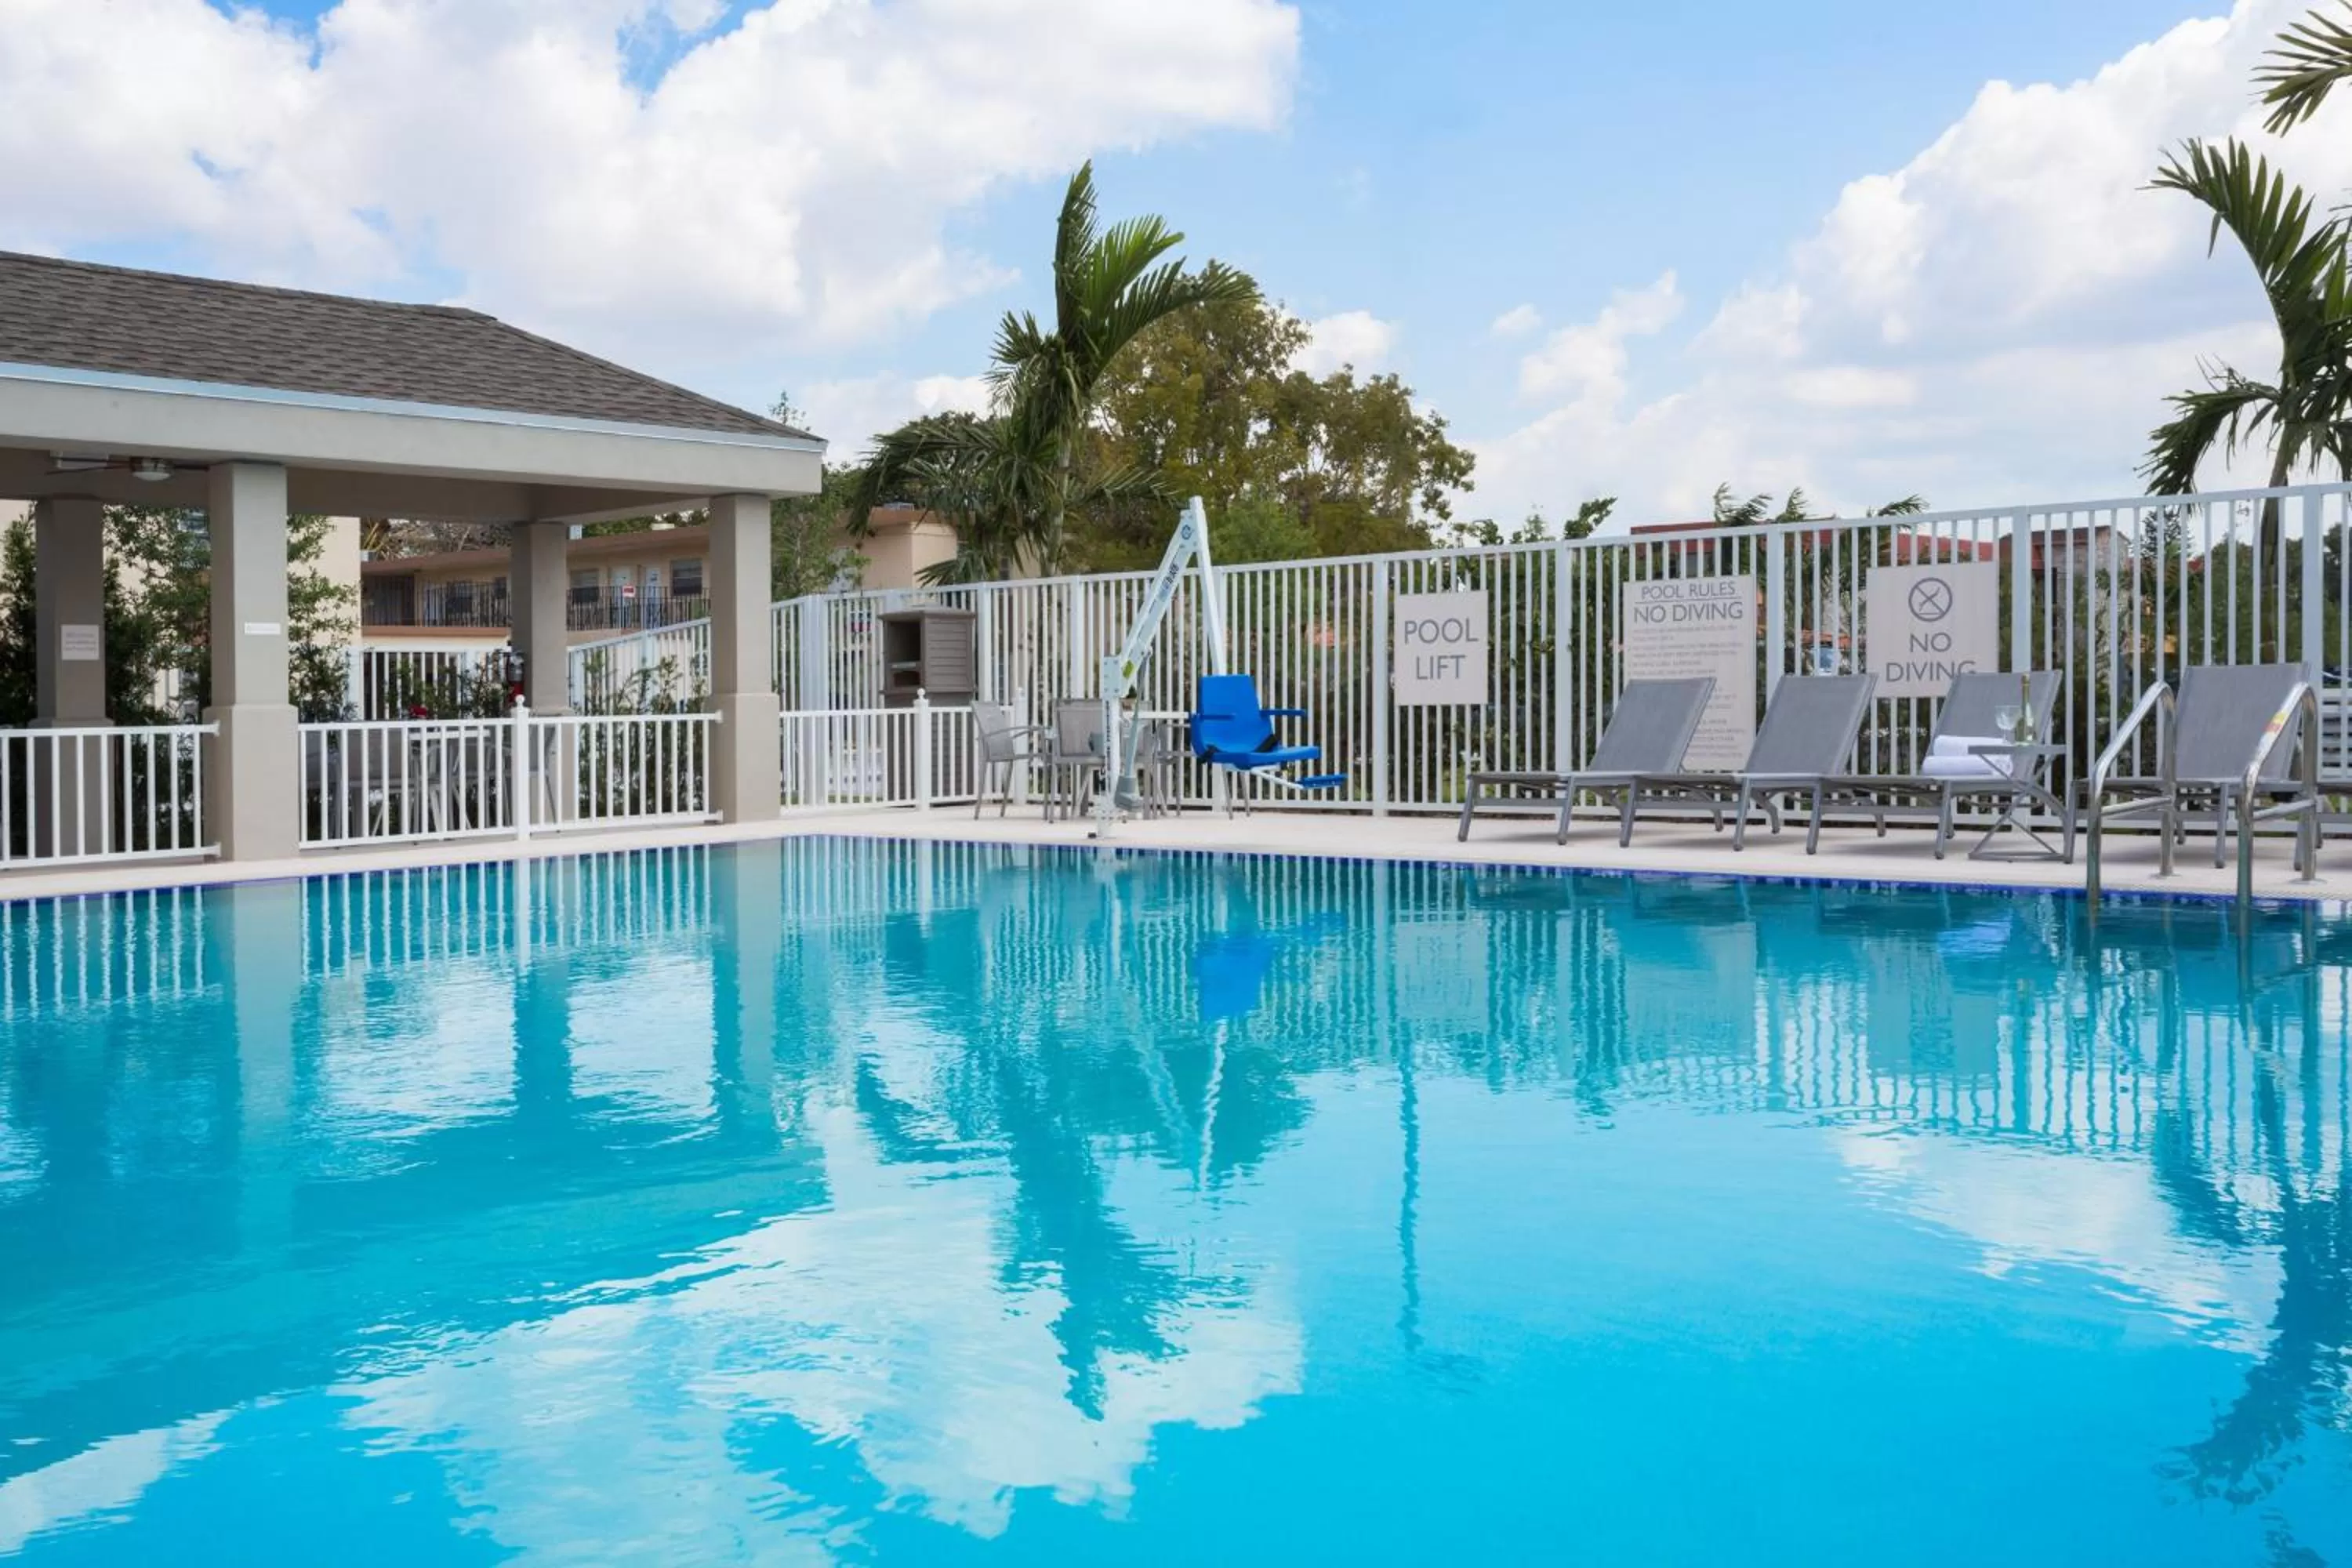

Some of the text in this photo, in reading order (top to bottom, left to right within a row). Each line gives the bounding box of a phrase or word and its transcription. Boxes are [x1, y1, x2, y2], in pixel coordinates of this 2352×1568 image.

[1641, 581, 1736, 599] POOL RULES
[1634, 601, 1743, 623] NO DIVING
[1404, 617, 1479, 644] POOL
[1910, 632, 1951, 652] NO
[1416, 655, 1467, 680] LIFT
[1886, 660, 1976, 682] DIVING
